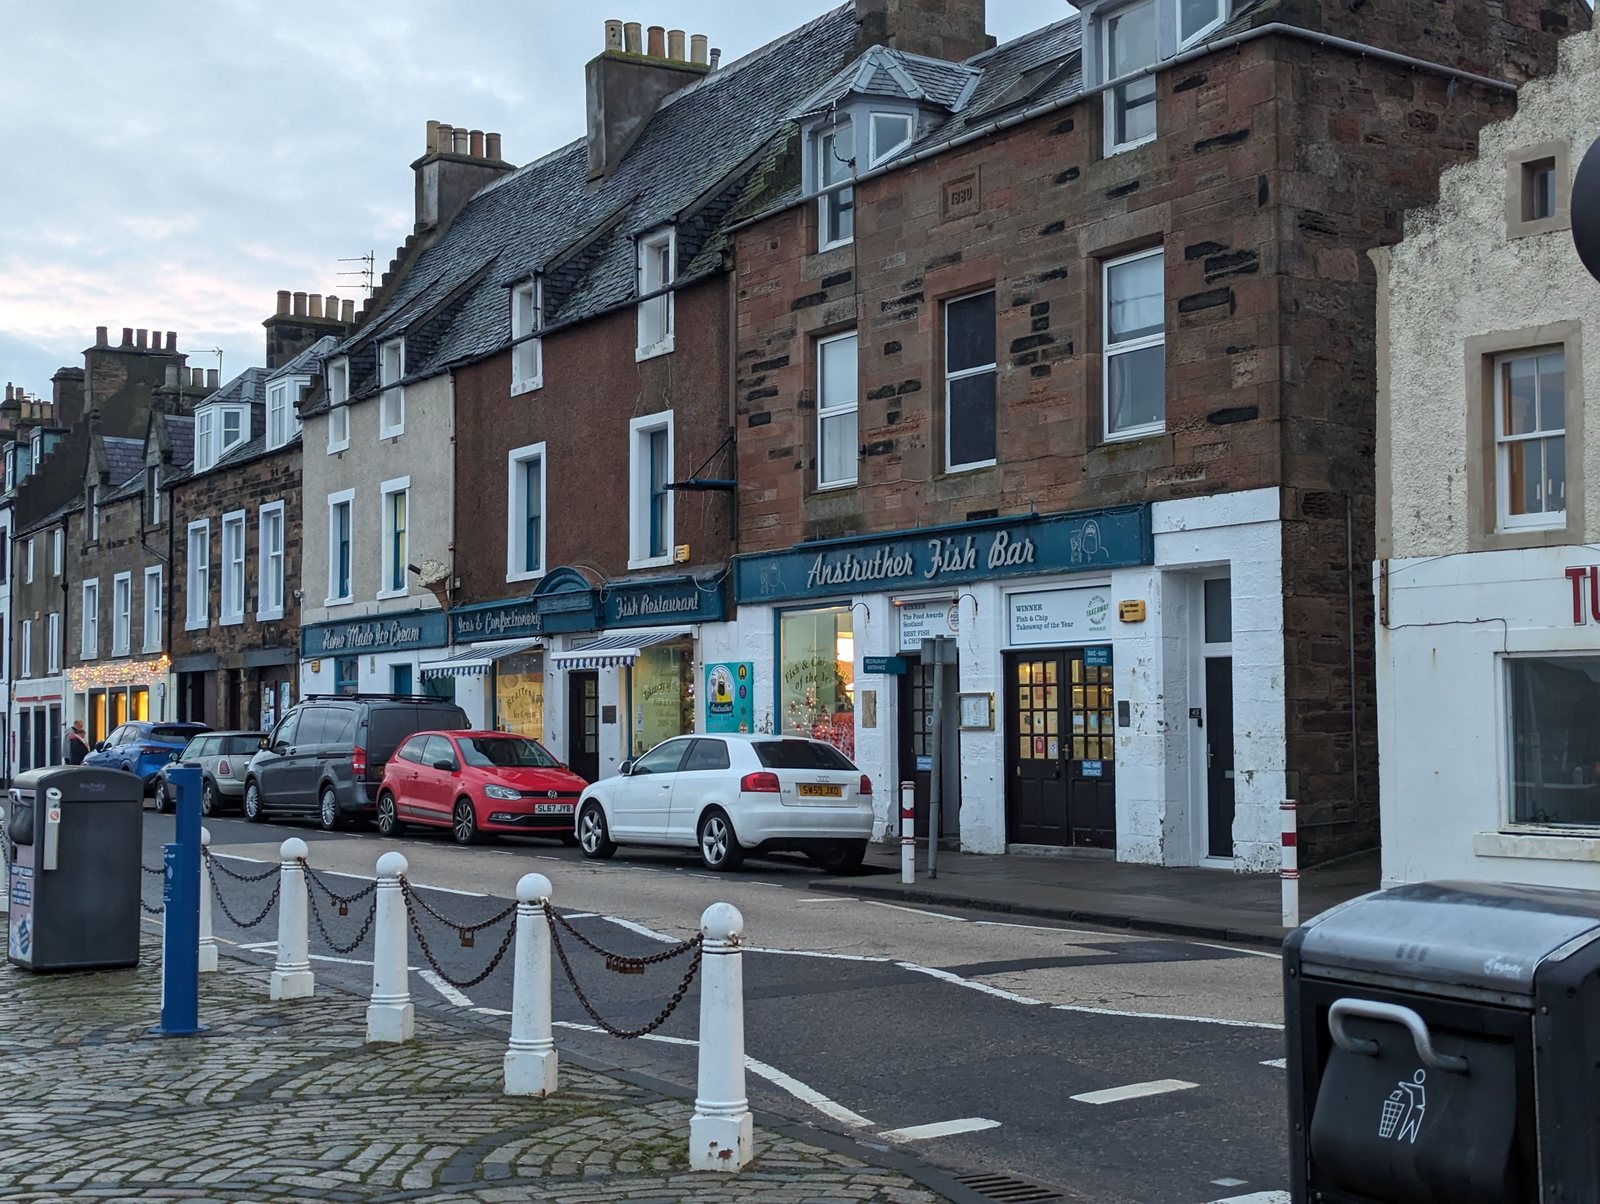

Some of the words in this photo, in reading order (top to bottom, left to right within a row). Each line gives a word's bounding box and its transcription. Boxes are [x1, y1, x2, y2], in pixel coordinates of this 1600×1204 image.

[807, 545, 913, 588] Anstruther
[924, 536, 975, 578] Fish
[988, 530, 1034, 569] Bar
[616, 595, 639, 620] Fish
[641, 591, 698, 614] Restaurant
[1016, 604, 1043, 613] WINNER
[1086, 603, 1109, 617] TAKEAWAY
[926, 611, 944, 619] Awards
[1016, 615, 1029, 623] Fish
[1034, 614, 1049, 623] Chip
[458, 616, 474, 633] Ices
[485, 609, 541, 634] Confectionery
[903, 620, 924, 628] Scotland
[1016, 623, 1043, 632] Takeaway
[1044, 622, 1050, 630] of
[1060, 620, 1074, 629] Year
[323, 628, 345, 650] Home
[347, 624, 374, 648] Made
[375, 622, 389, 646] Ice
[390, 620, 420, 646] Cream
[903, 630, 917, 638] BEST
[917, 629, 931, 637] FISH
[908, 637, 922, 645] CHIP
[785, 664, 800, 684] Fish
[802, 659, 808, 670] &
[795, 674, 803, 691] of
[802, 785, 823, 795] SW59
[537, 805, 556, 813] SL67
[557, 805, 571, 813] JYB
